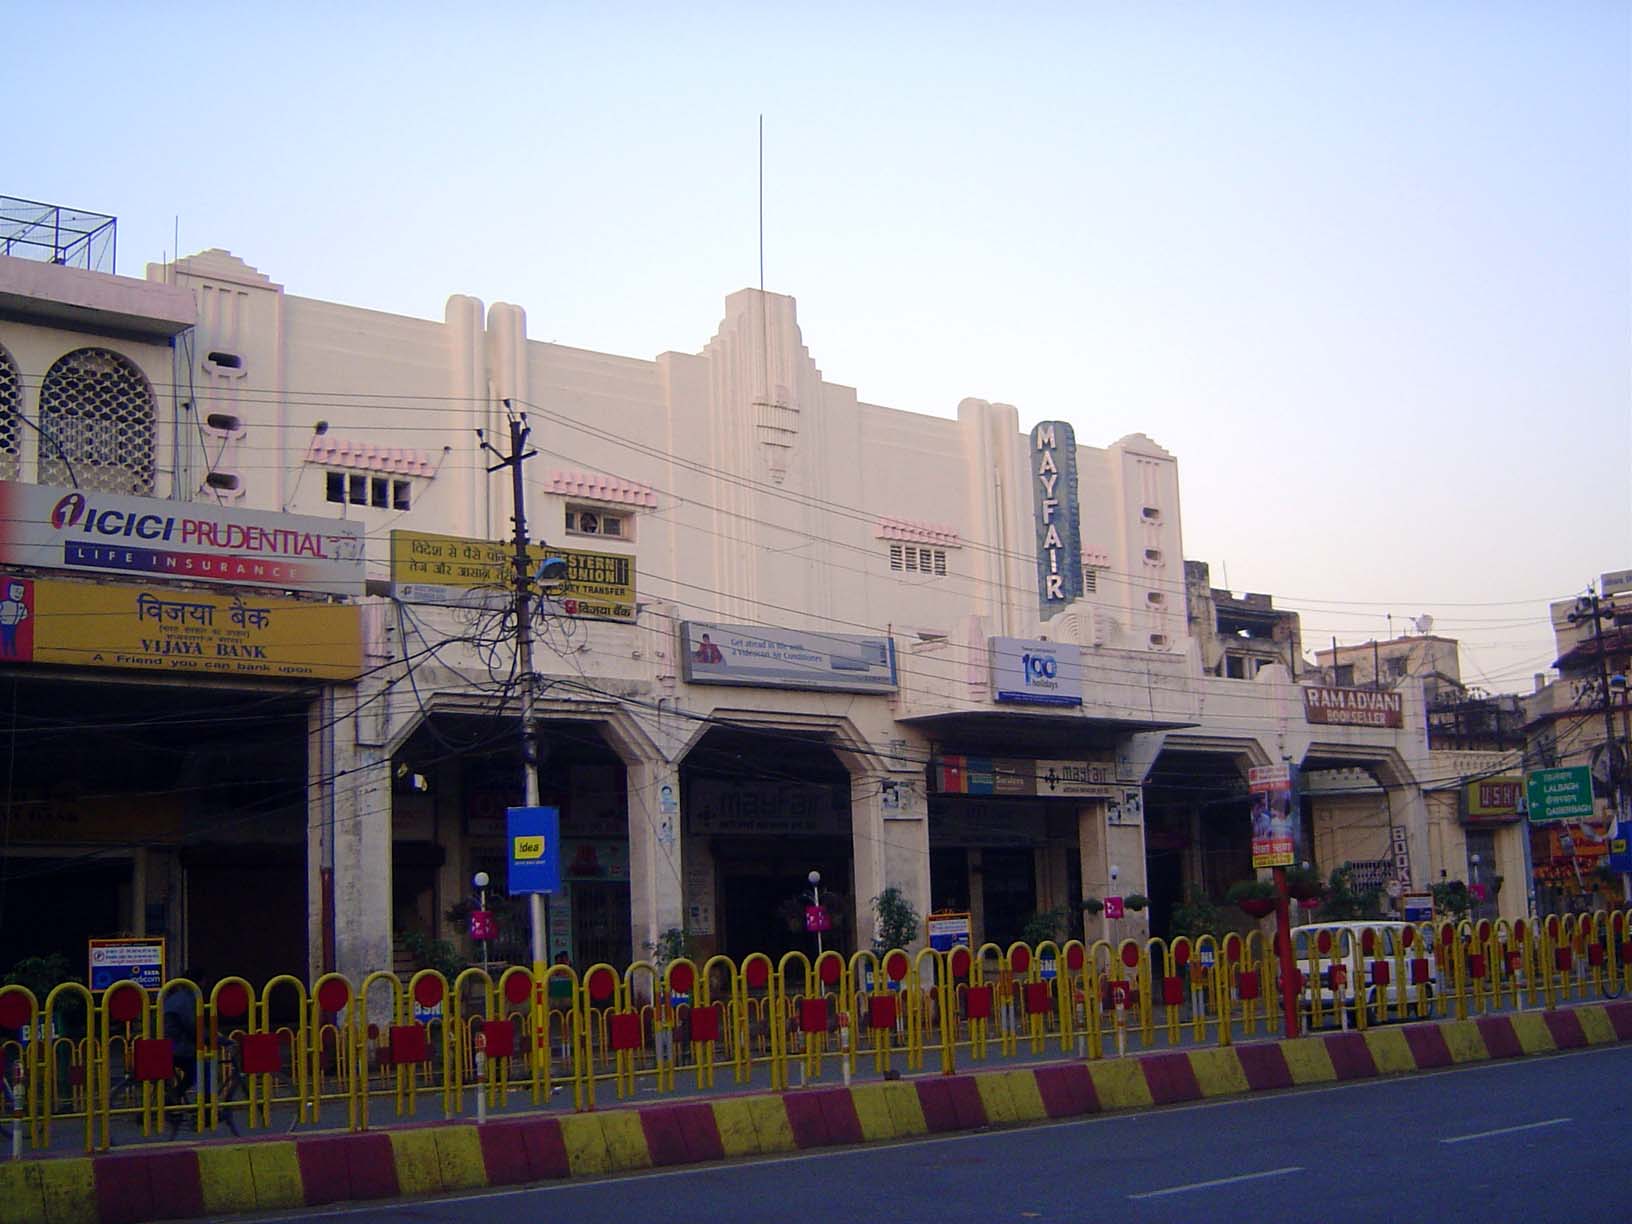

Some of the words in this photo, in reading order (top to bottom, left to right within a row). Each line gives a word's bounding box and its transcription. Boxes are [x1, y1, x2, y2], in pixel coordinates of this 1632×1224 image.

[1037, 425, 1064, 600] MAYFAIR
[84, 509, 174, 541] ICICI
[182, 519, 329, 559] PRUDENTIAL
[78, 549, 134, 563] LIFE
[153, 556, 298, 578] INSURANCE
[568, 567, 615, 583] UNION
[584, 585, 625, 597] TRANSFER
[136, 592, 217, 626] विजया
[228, 596, 271, 630] बैंक
[142, 639, 203, 656] VIJAYA
[216, 643, 267, 659] BANK
[93, 654, 104, 662] A
[116, 654, 163, 667] Friend
[171, 658, 198, 670] you
[205, 661, 231, 670] can
[238, 663, 271, 673] bank
[279, 666, 313, 676] upon
[1307, 688, 1344, 708] RAM
[1347, 691, 1401, 712] ADVANI
